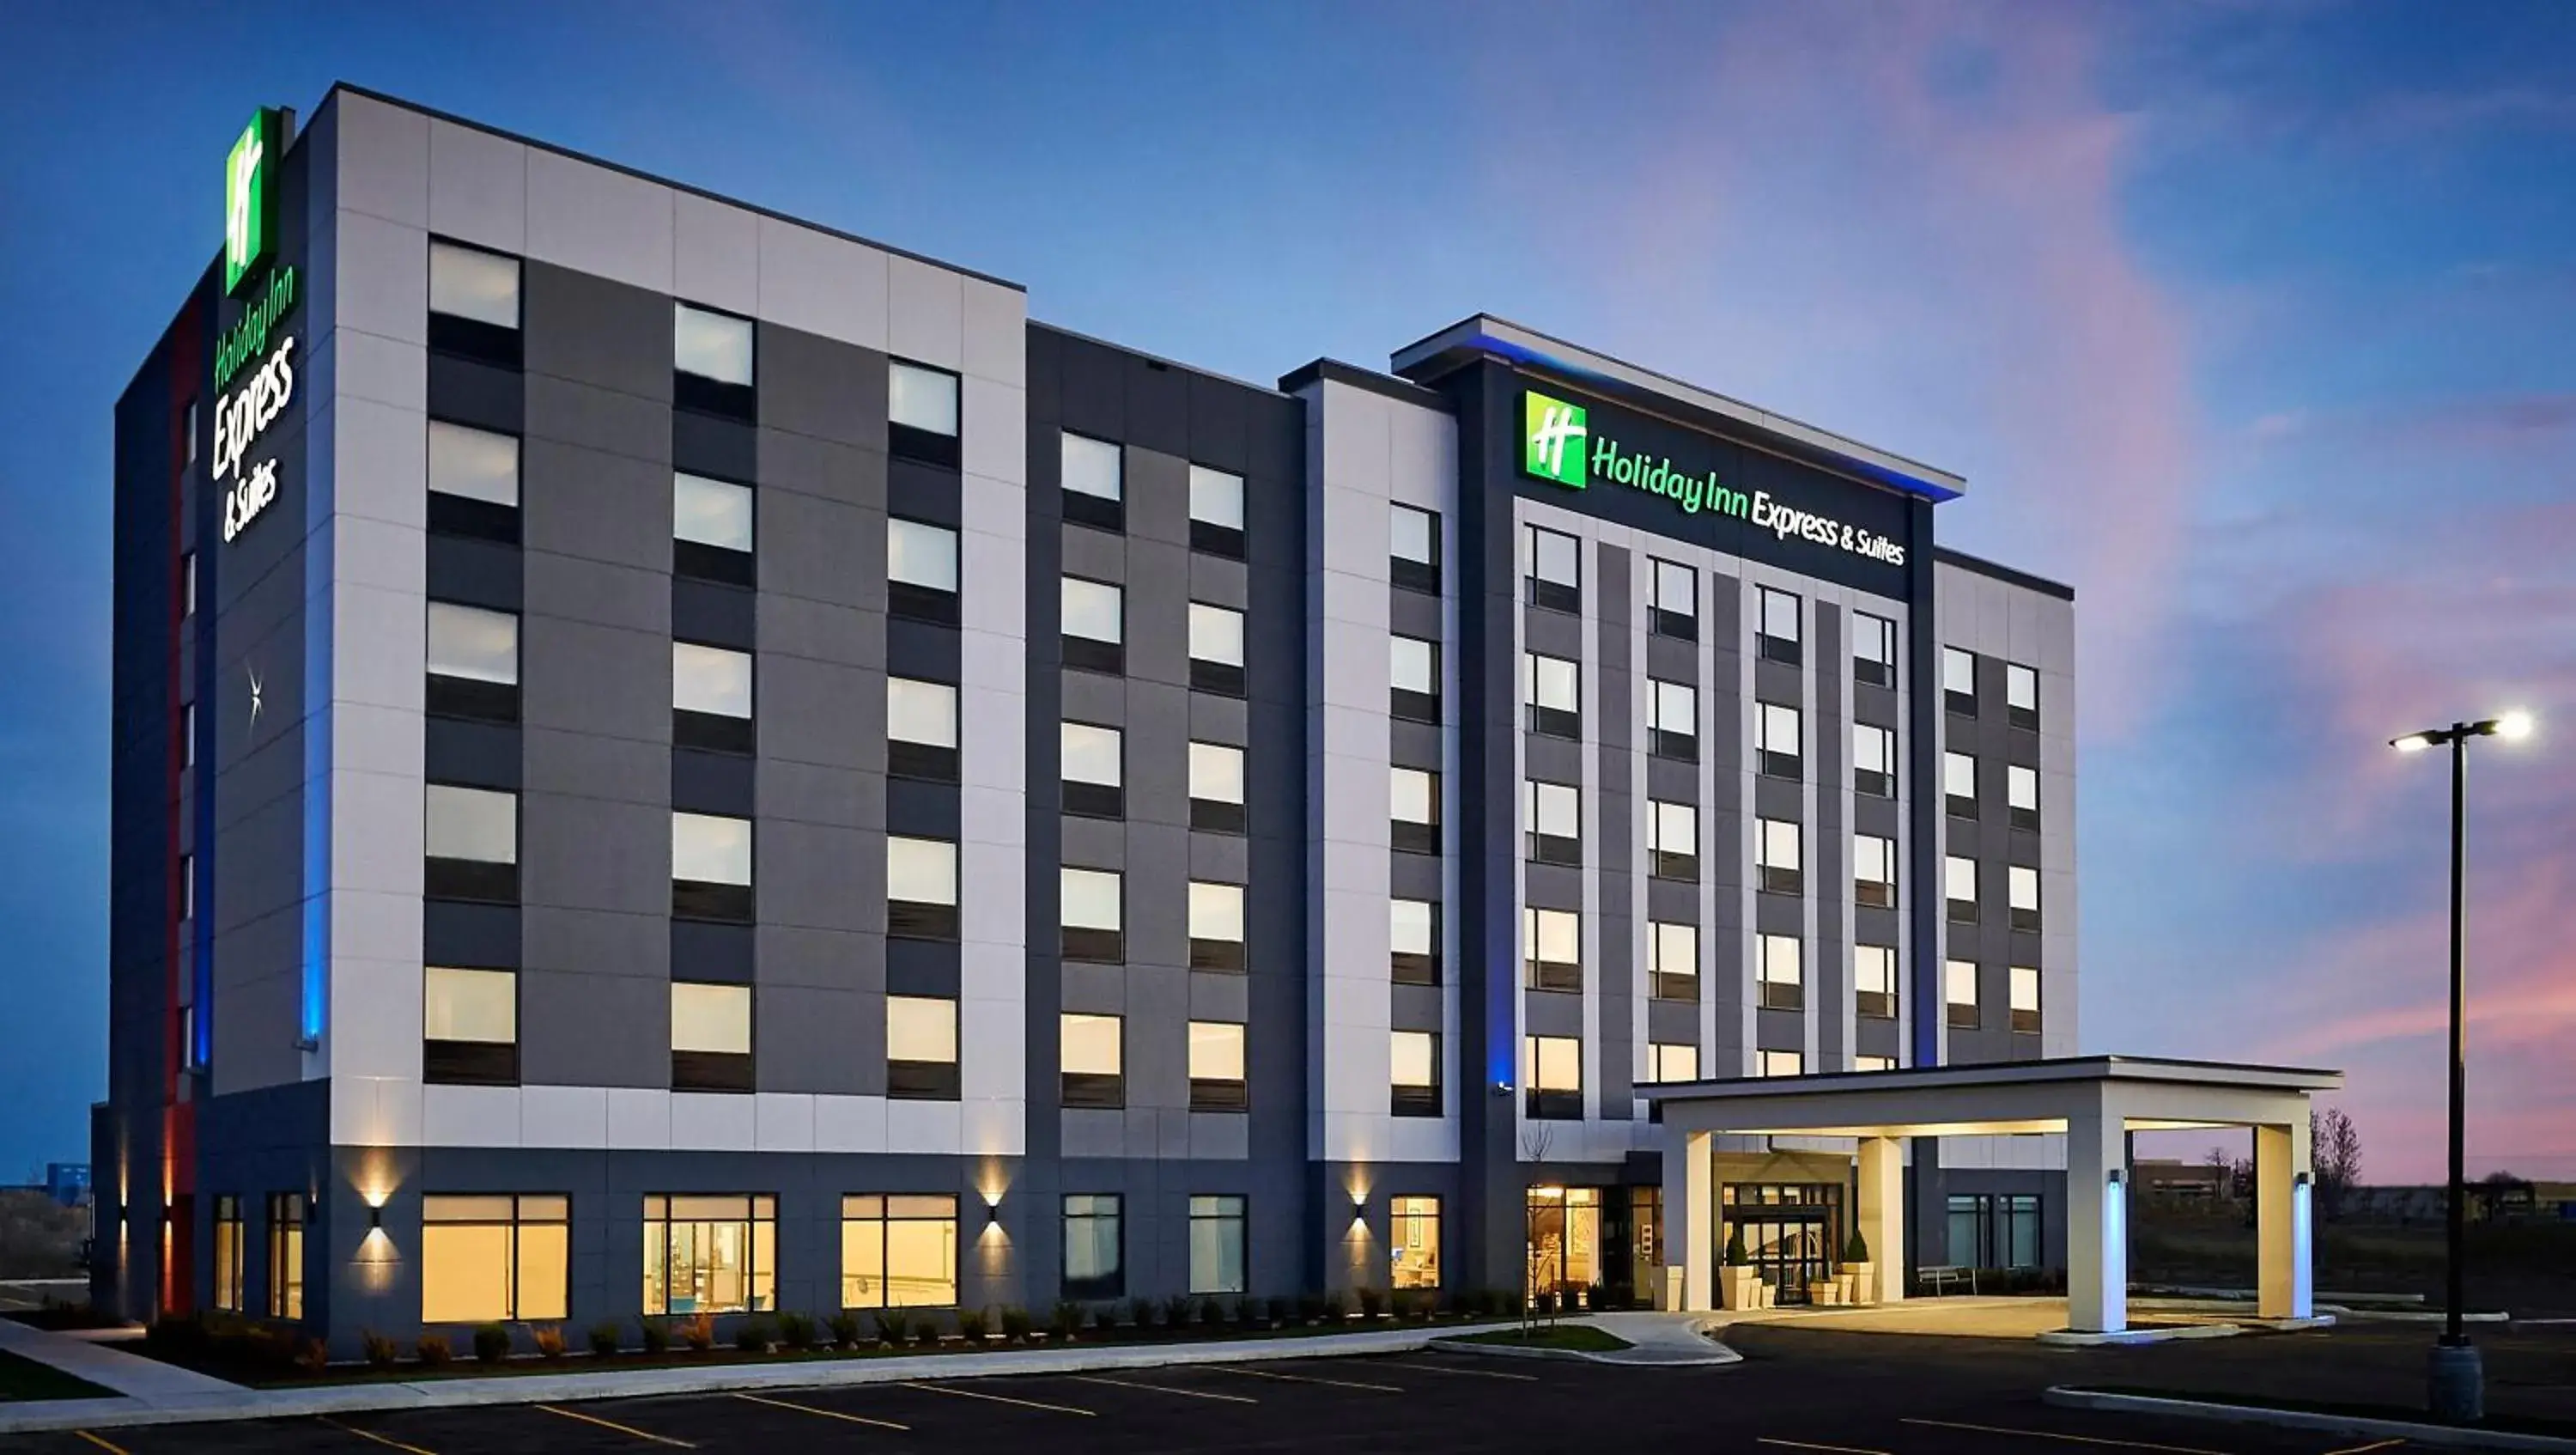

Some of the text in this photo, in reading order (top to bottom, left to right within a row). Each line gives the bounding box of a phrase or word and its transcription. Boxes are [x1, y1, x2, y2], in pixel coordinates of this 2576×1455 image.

[215, 265, 293, 395] Holiday Inn
[213, 336, 294, 480] Express
[224, 458, 276, 543] & Suites
[1591, 435, 1905, 566] Holiday Inn Express & Suites
